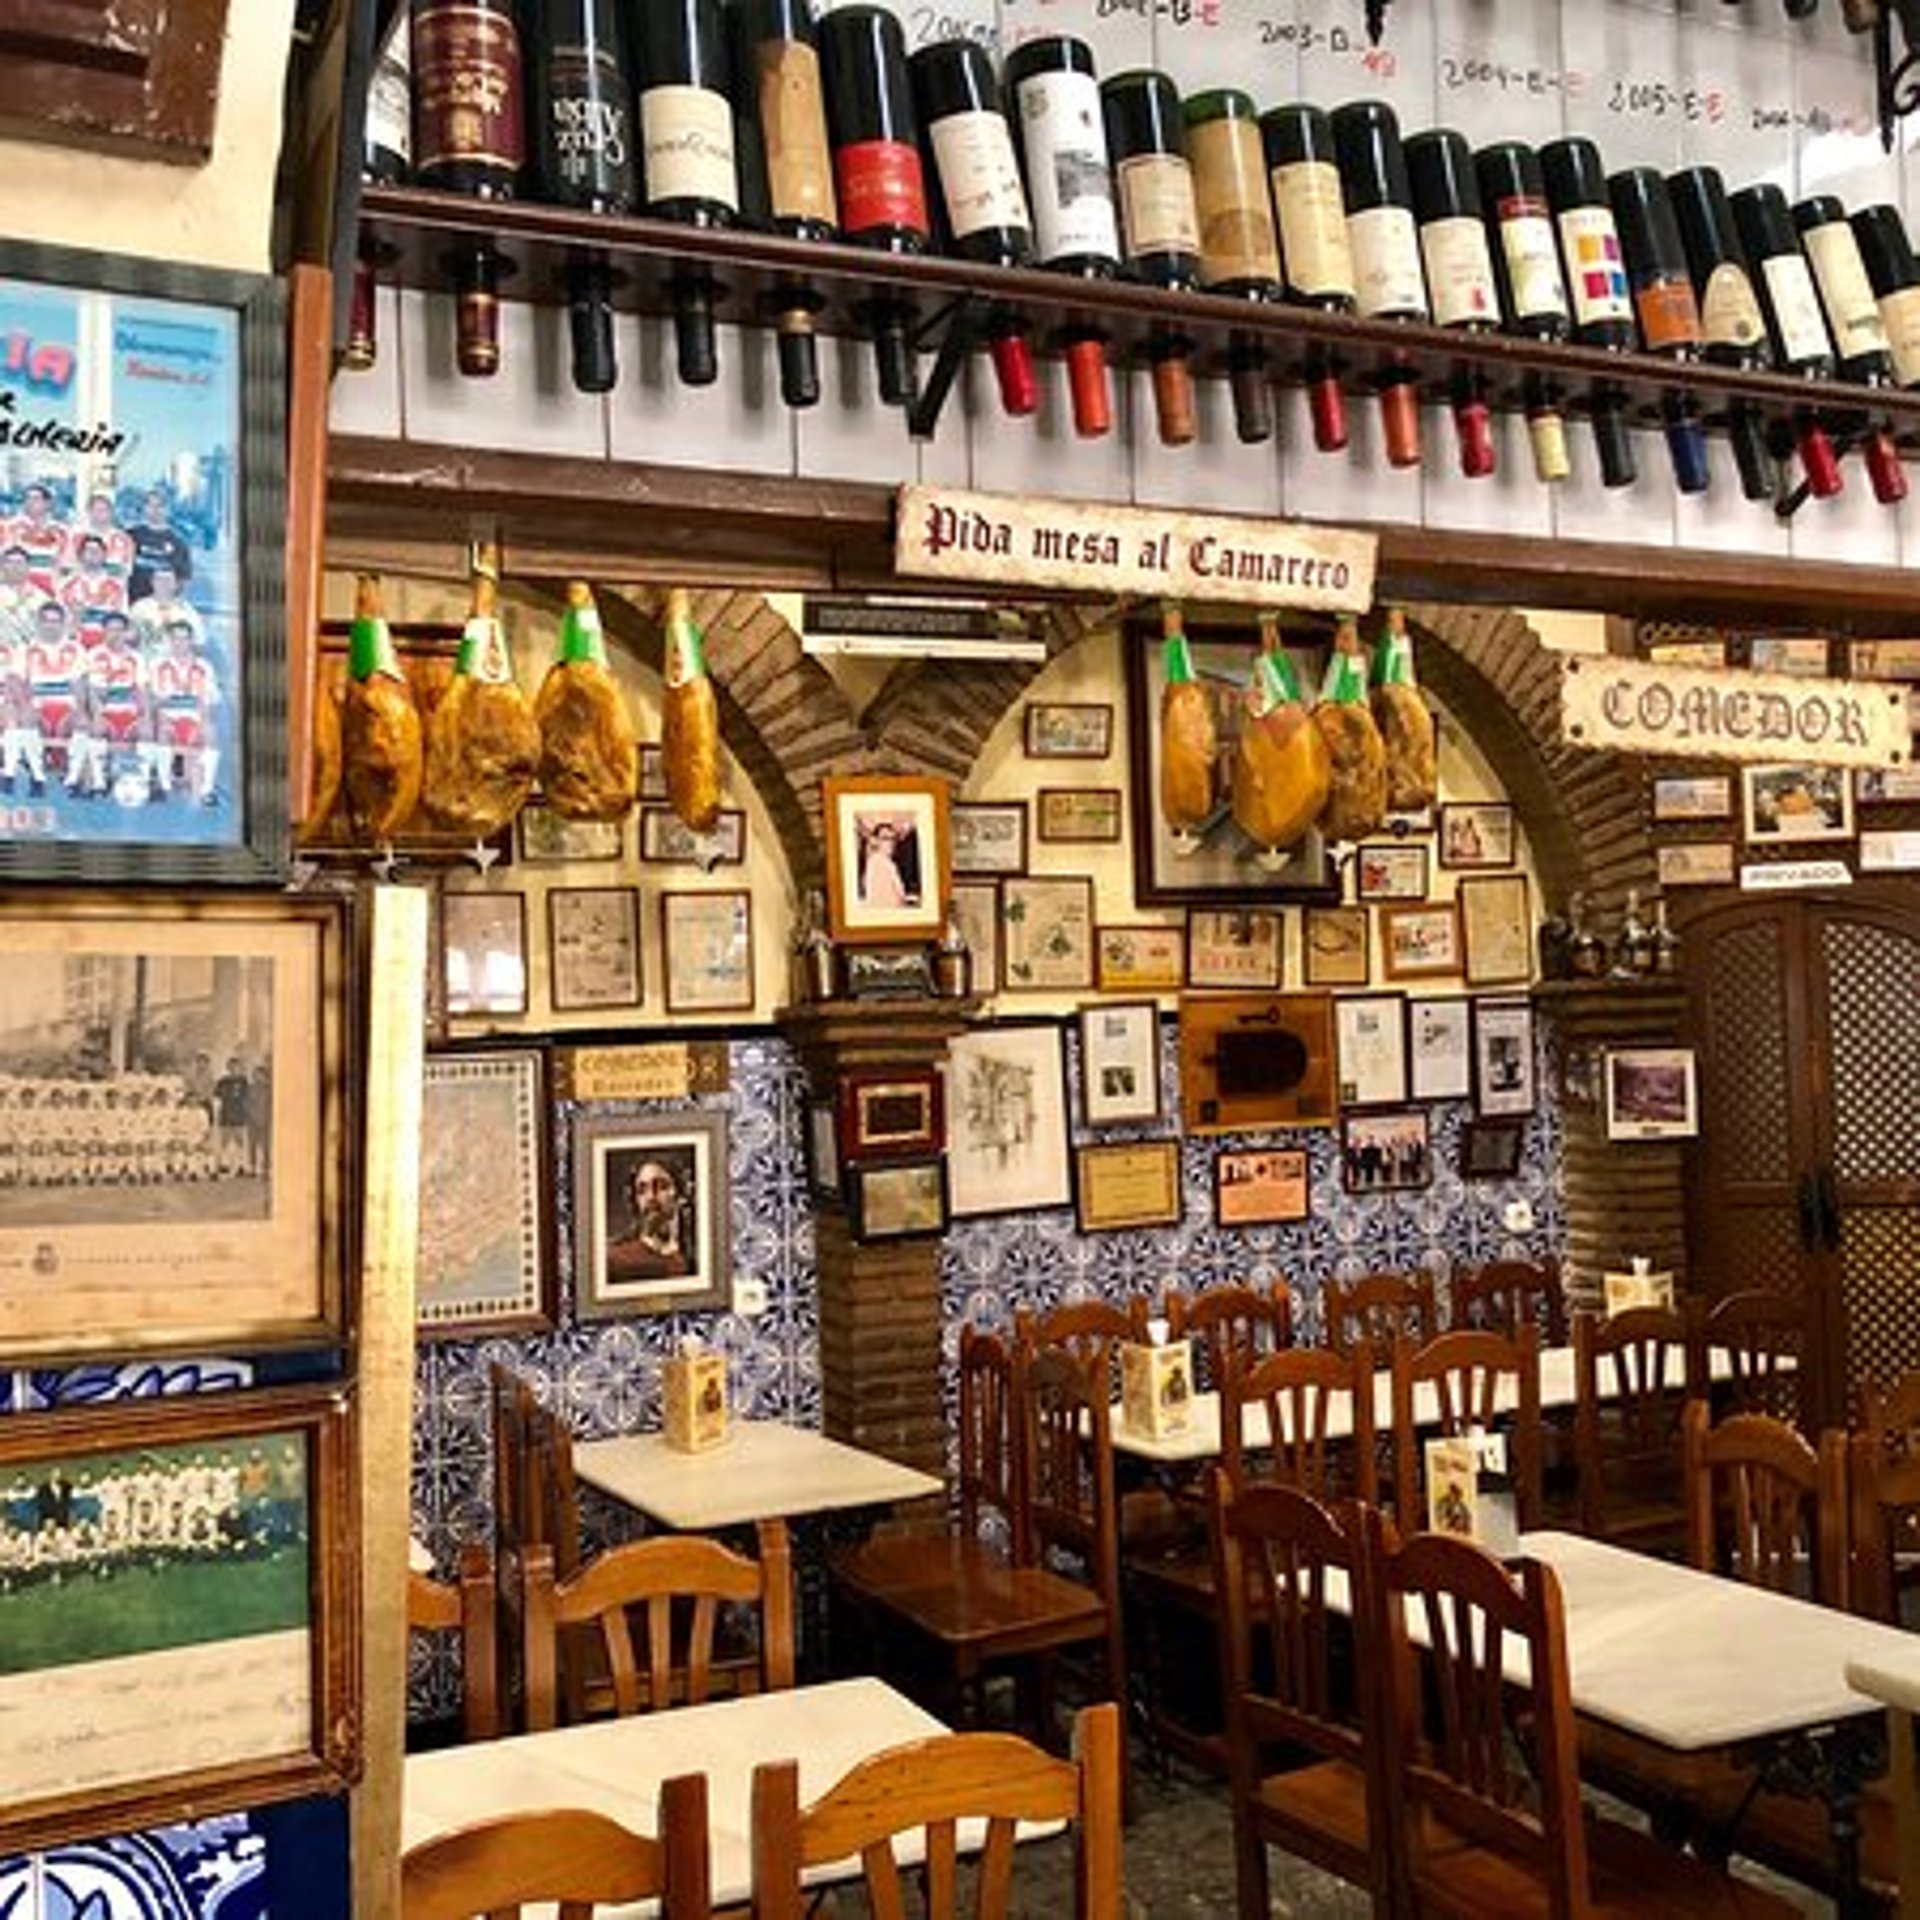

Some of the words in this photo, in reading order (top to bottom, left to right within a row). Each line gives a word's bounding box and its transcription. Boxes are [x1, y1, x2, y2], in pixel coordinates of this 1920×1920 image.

[924, 502, 1012, 555] Pida
[1031, 526, 1120, 566] mesa
[1138, 533, 1171, 573] al
[1189, 536, 1350, 590] Camarero
[1603, 680, 1869, 748] COMEDOR
